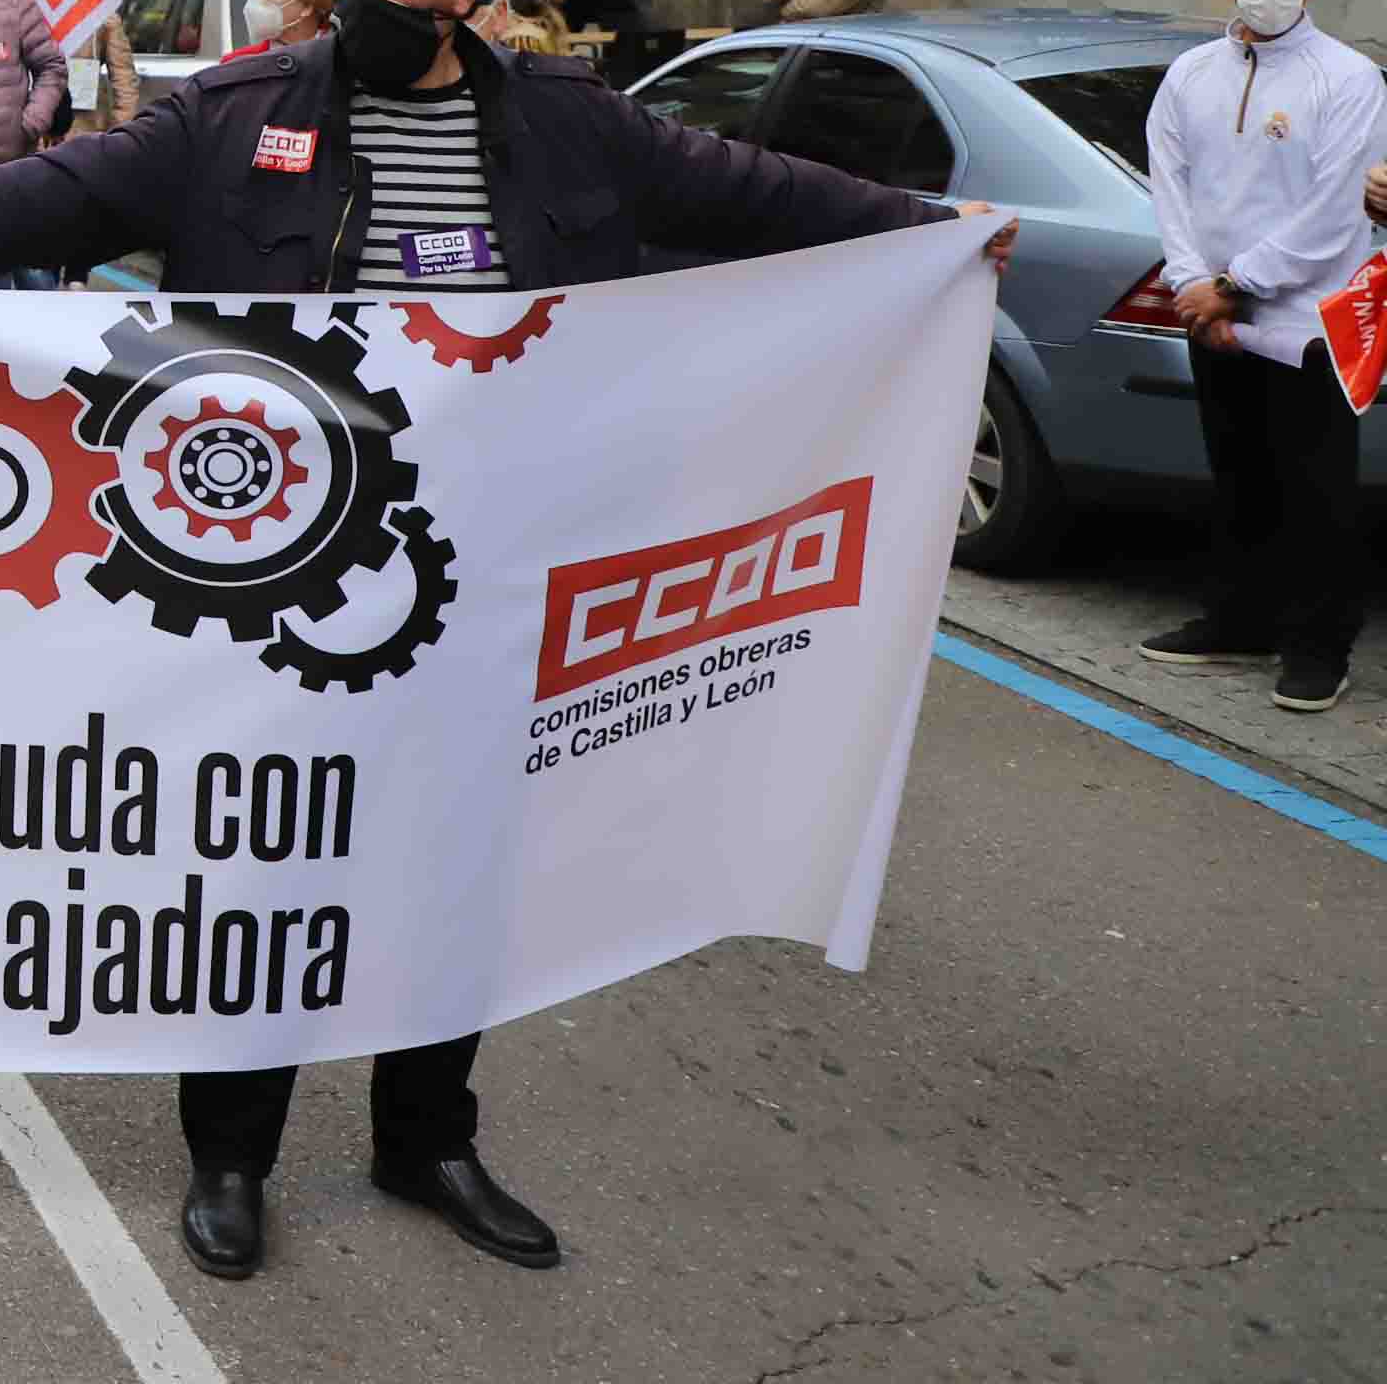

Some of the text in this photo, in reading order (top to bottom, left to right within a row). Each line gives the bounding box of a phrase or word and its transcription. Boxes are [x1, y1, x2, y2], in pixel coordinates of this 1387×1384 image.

[419, 235, 465, 250] CCOO
[562, 508, 845, 669] CCOO
[524, 670, 777, 775] de Castilla y León
[528, 627, 812, 739] comisiones obreras
[193, 752, 356, 862] con
